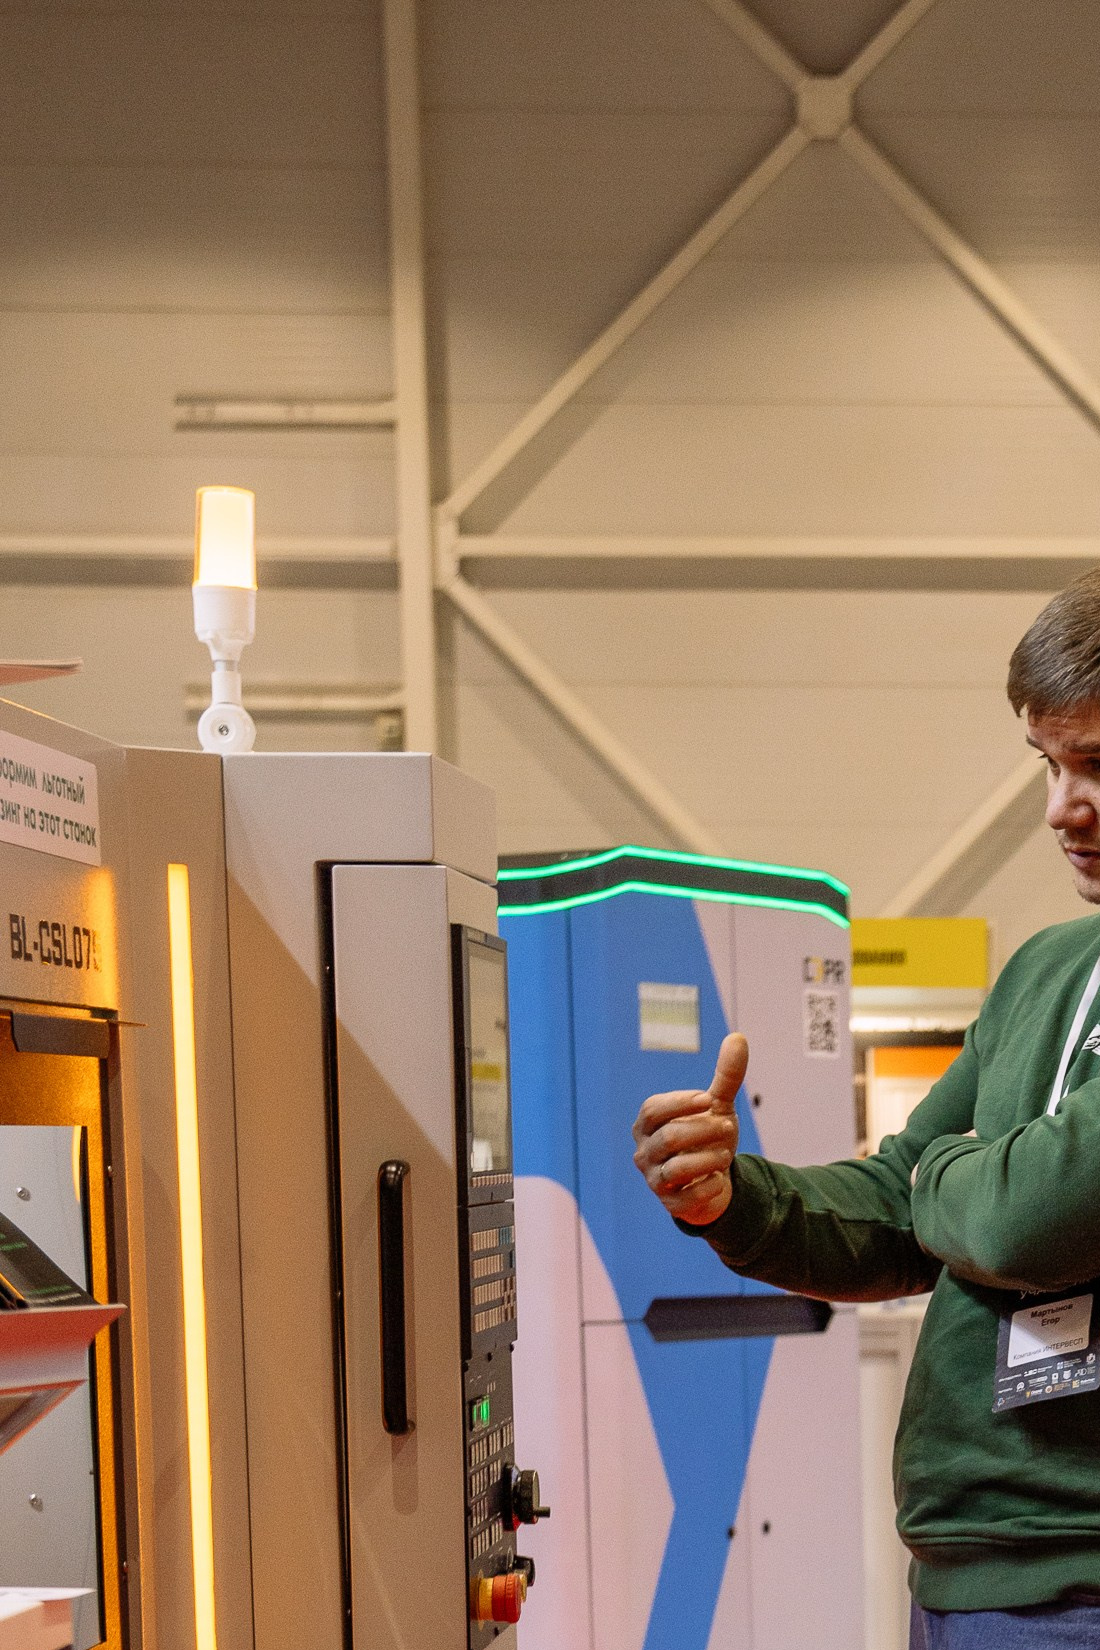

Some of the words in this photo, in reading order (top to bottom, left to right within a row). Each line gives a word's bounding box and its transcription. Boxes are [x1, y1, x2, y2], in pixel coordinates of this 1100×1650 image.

[42, 772, 85, 805] льготный
[24, 807, 36, 831] на
[39, 811, 60, 837] этот
[63, 818, 97, 848] станок
[1030, 1304, 1073, 1318] Мартынов
[1041, 1317, 1060, 1326] Егор
[1043, 1337, 1083, 1354] ИНТЕРВЕСП
